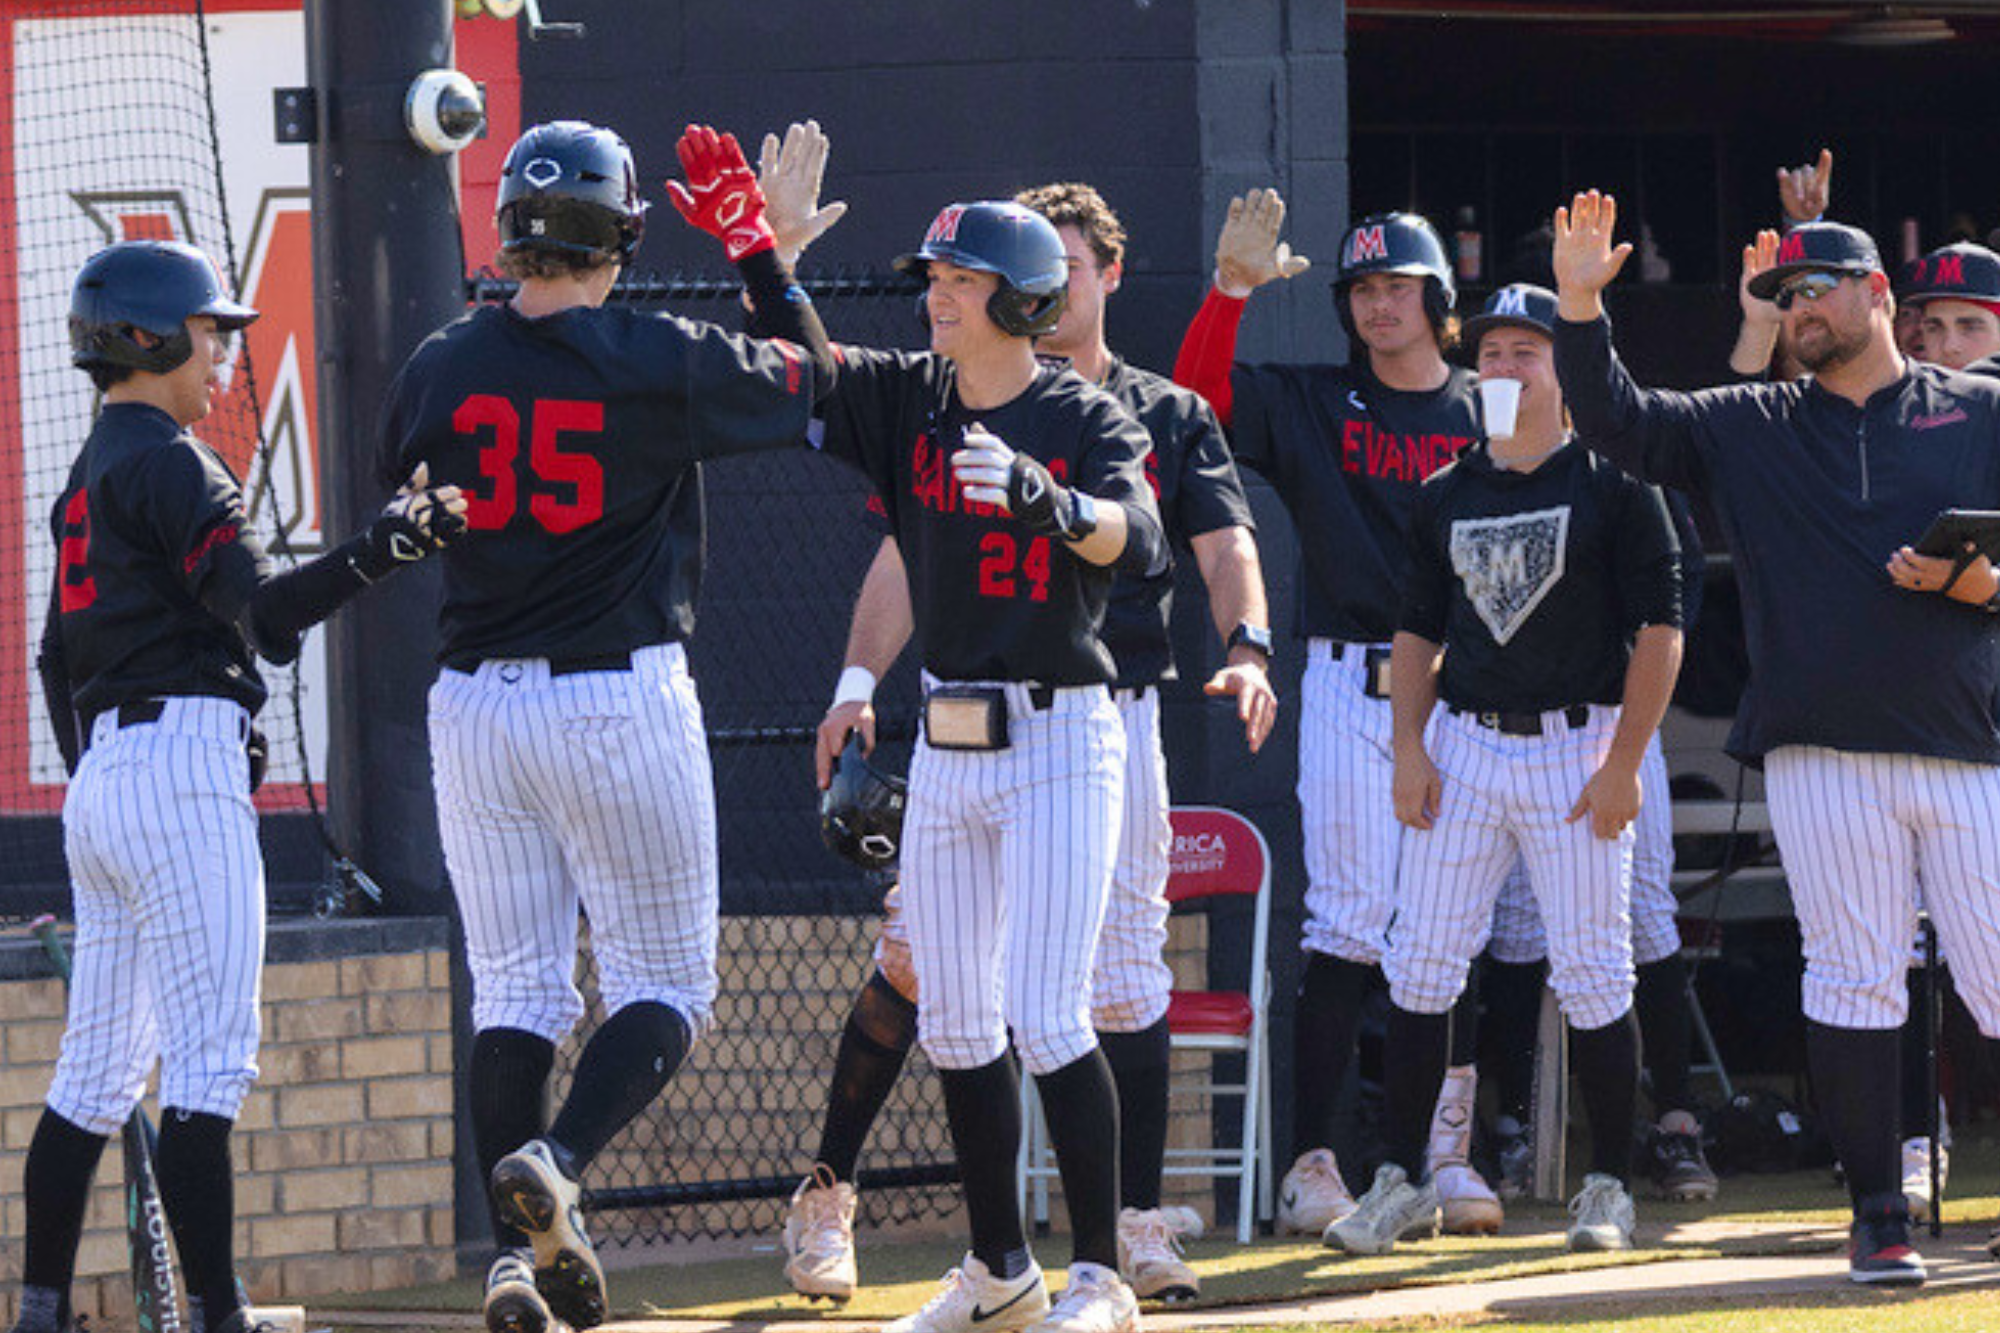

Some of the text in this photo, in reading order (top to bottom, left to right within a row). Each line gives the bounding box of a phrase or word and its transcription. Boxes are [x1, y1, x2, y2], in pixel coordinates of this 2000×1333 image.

[926, 206, 965, 242] M
[1353, 225, 1387, 261] M
[1780, 231, 1806, 264] M
[1935, 255, 1965, 285] M
[1493, 287, 1529, 316] M
[453, 394, 604, 534] 35
[978, 531, 1050, 601] 24
[1171, 832, 1226, 853] RICA
